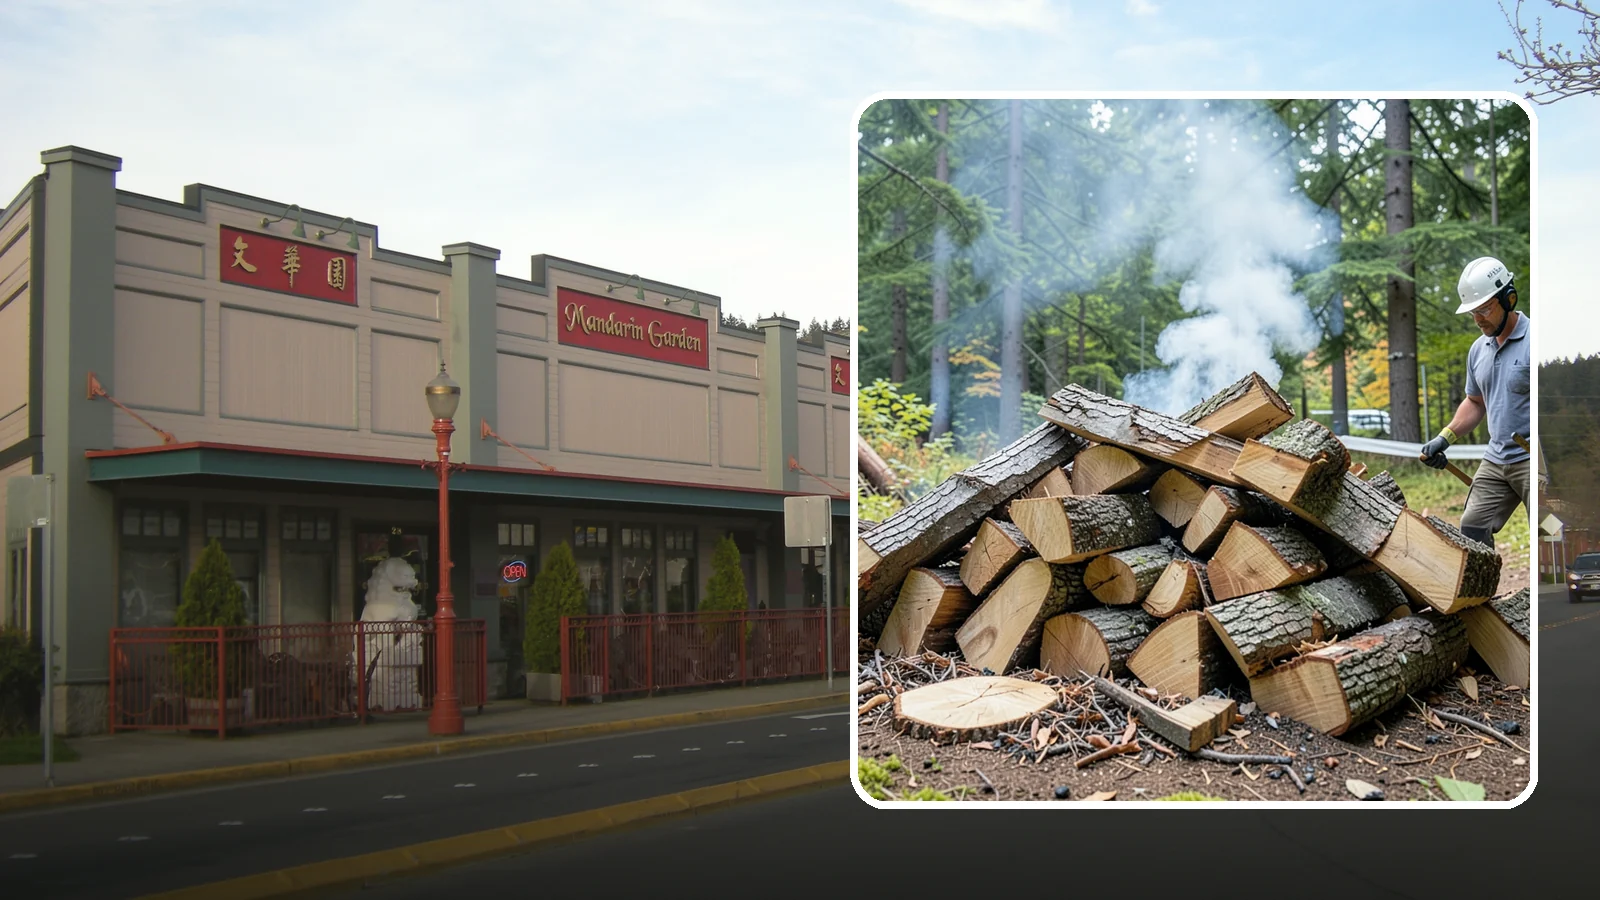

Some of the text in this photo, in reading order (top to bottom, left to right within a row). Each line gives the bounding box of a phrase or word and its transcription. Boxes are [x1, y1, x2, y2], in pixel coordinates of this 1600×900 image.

[231, 236, 346, 291] 文華園
[564, 302, 702, 352] Mandarin Garden
[503, 565, 526, 578] OPEN
